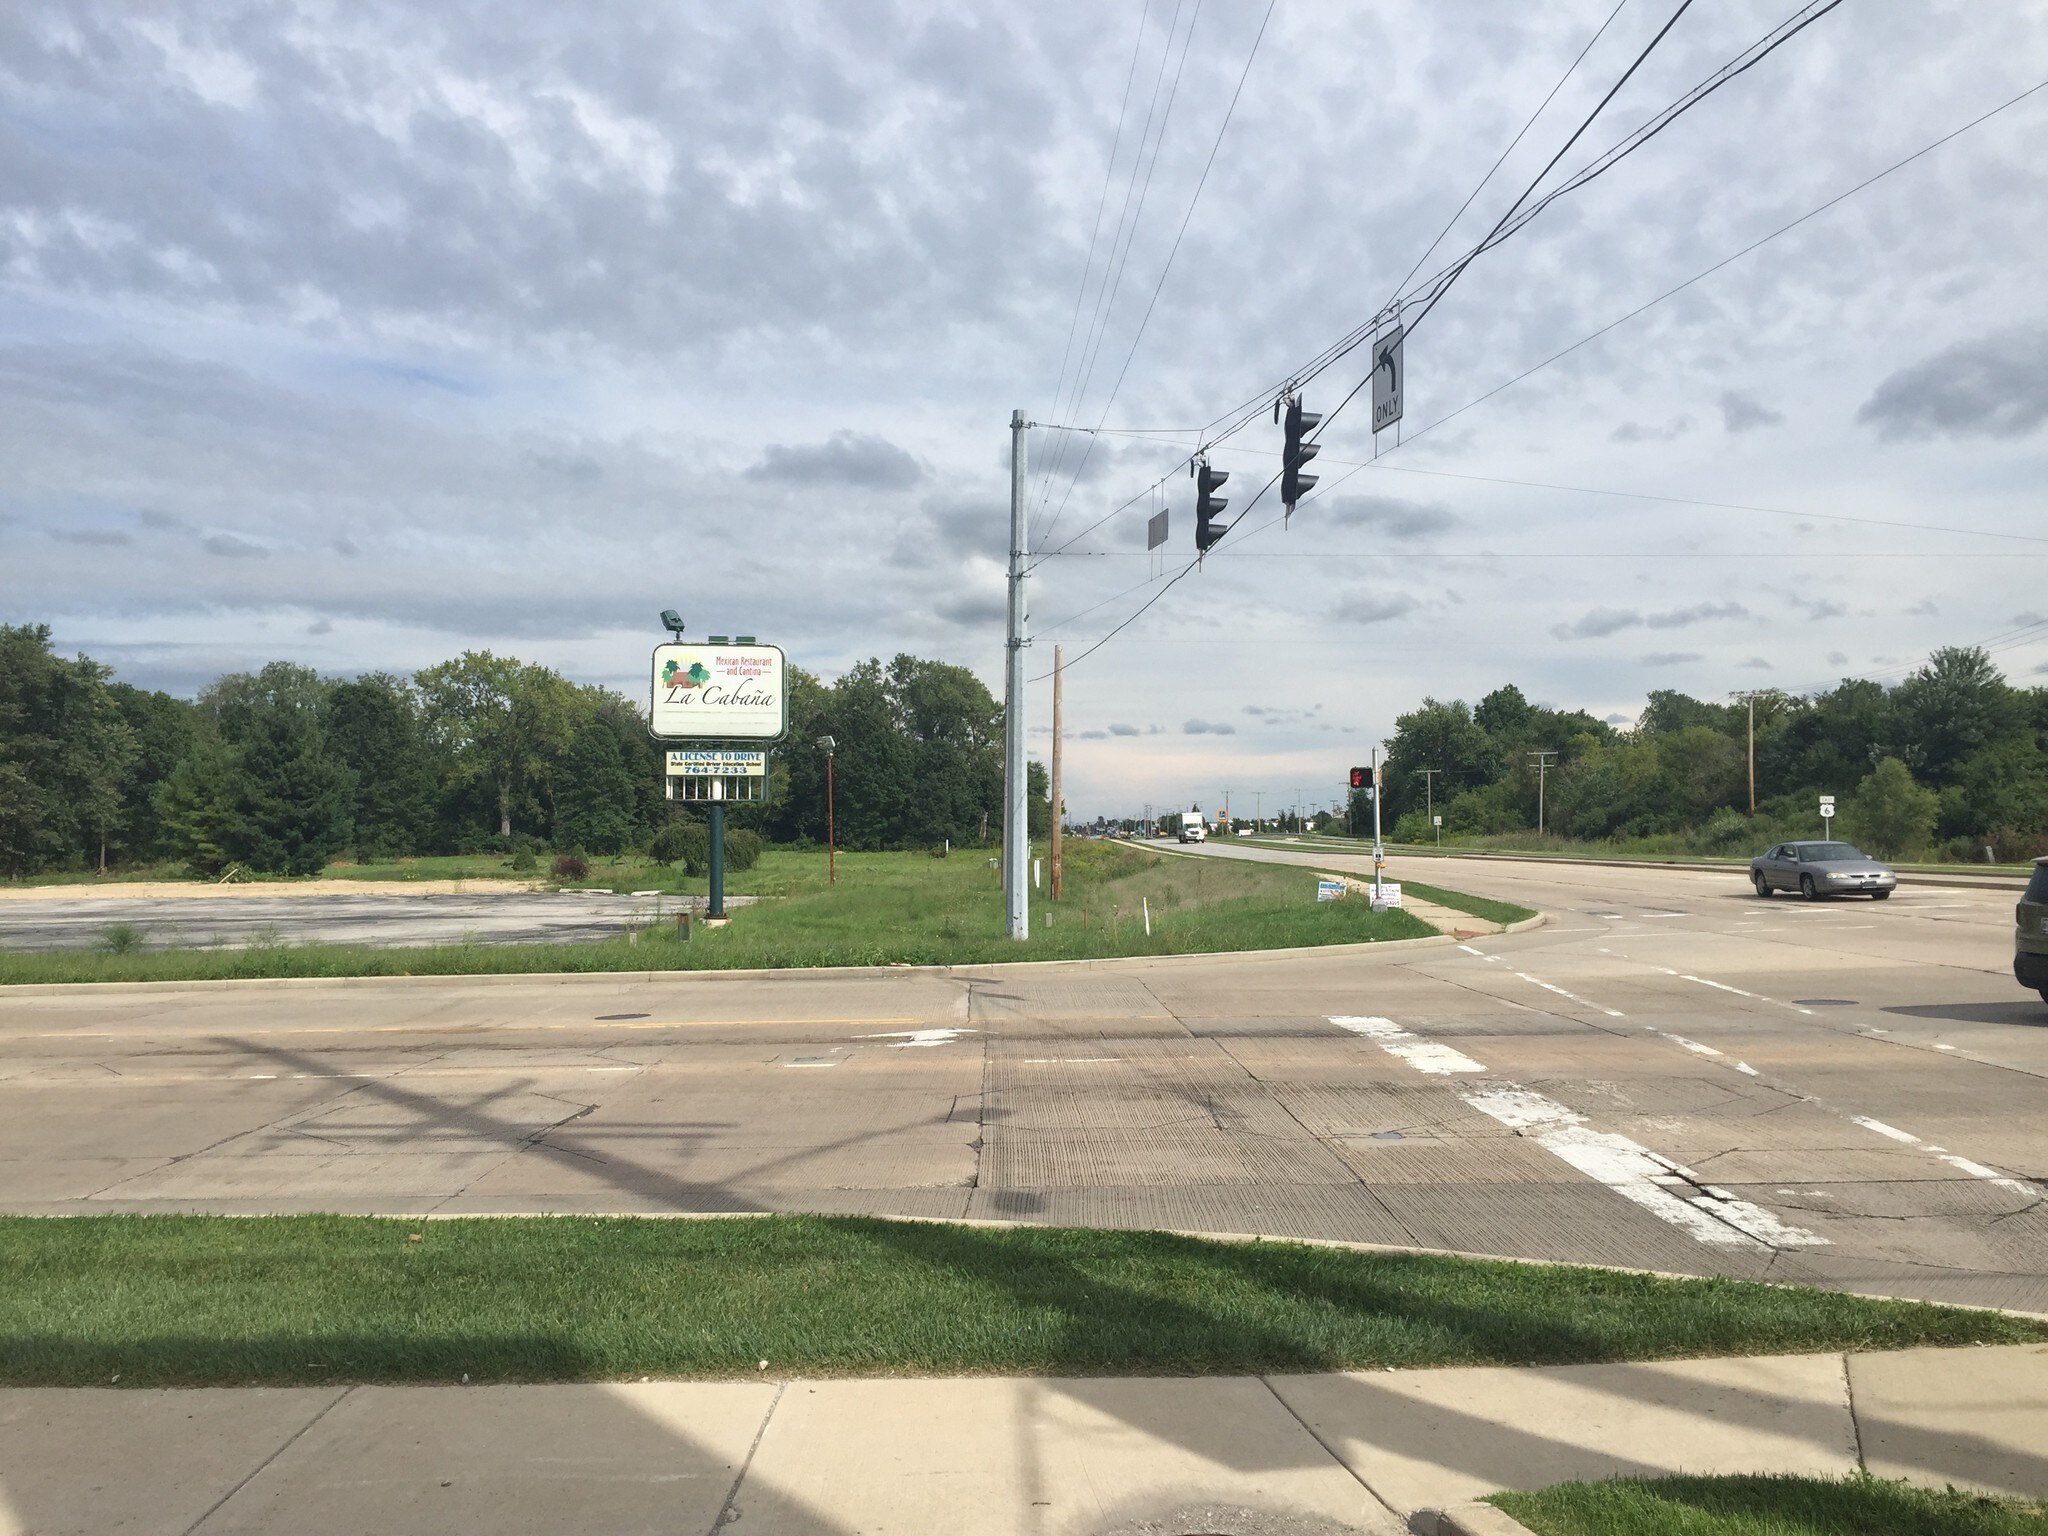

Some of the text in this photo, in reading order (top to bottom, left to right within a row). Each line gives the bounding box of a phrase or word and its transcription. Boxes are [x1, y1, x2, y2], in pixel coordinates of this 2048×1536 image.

[1376, 395, 1399, 423] ONLY
[716, 656, 772, 666] Mexican Restaurant
[726, 667, 762, 676] and Cantina
[664, 678, 776, 706] La Cabaña
[671, 752, 761, 761] A LICENSE TO DRIVE
[1824, 807, 1831, 815] 6
